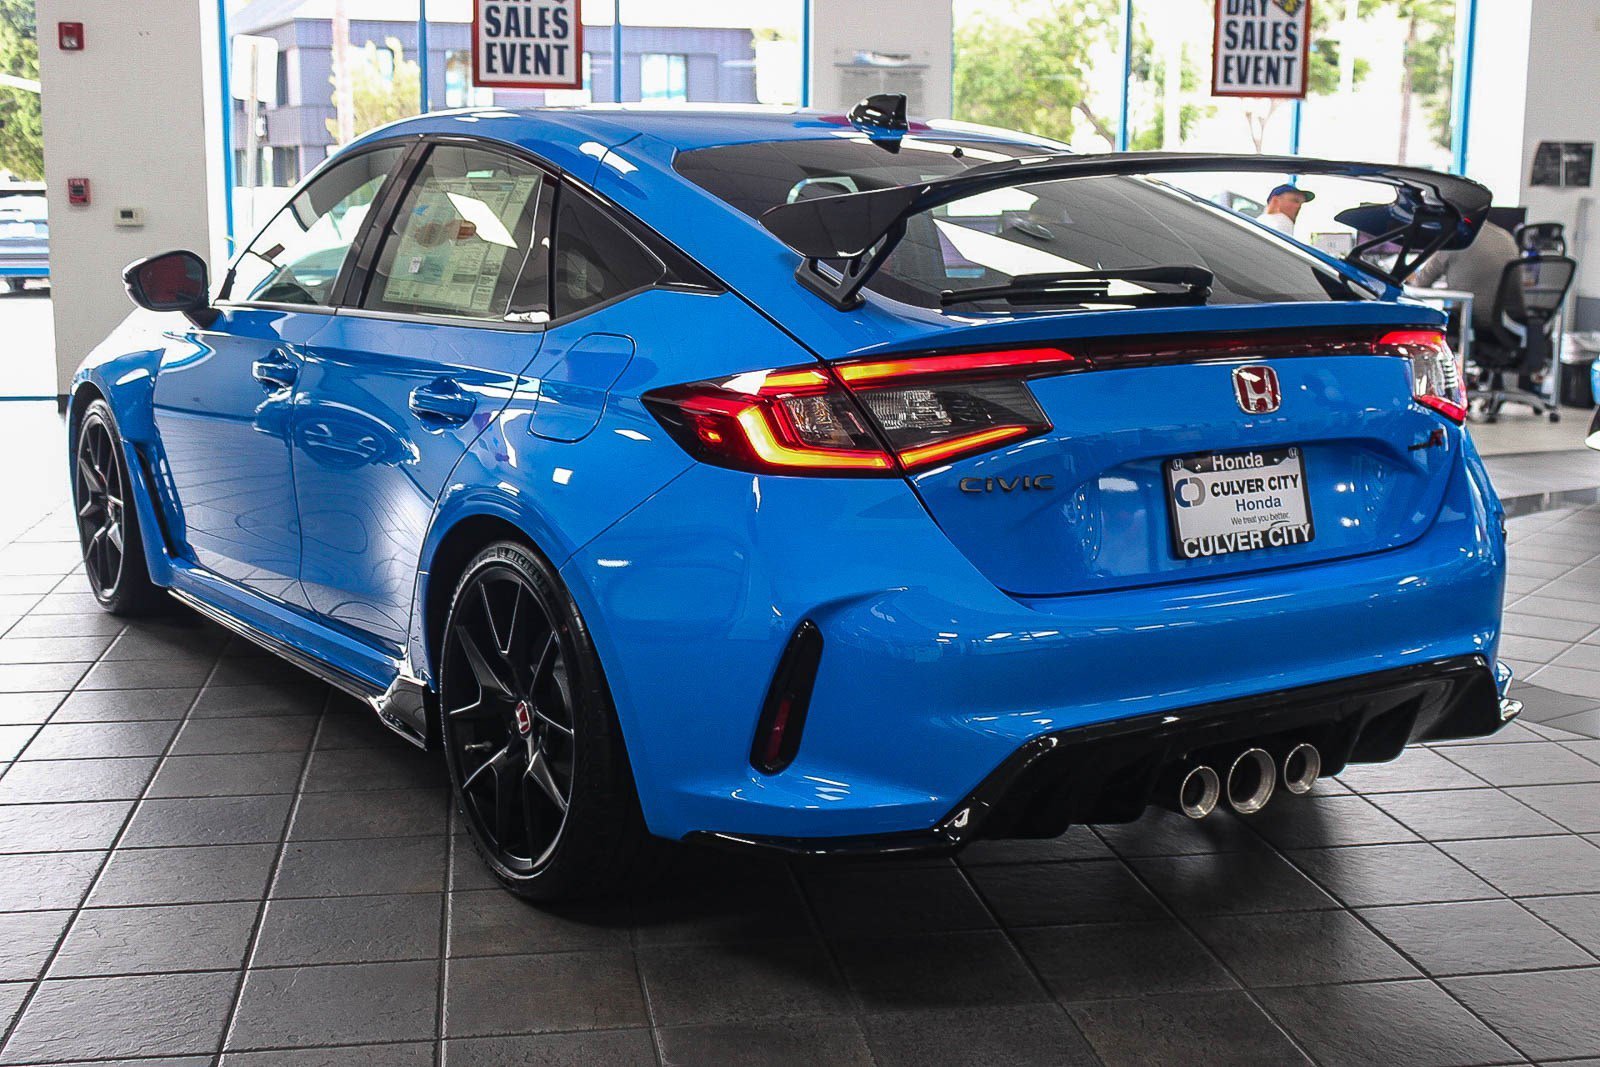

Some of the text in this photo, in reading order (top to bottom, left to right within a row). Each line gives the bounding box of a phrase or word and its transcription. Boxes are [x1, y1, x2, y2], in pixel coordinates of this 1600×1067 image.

[485, 5, 569, 39] SALES
[1225, 20, 1297, 51] SALES
[486, 42, 569, 75] EVENT
[1223, 55, 1297, 85] EVENT
[1212, 452, 1264, 471] Honda
[960, 475, 1056, 492] CIVIC
[1210, 474, 1299, 497] CULVER CITY
[1236, 496, 1281, 512] Honda
[1231, 516, 1242, 525] We
[1258, 515, 1269, 524] you
[1184, 523, 1311, 558] CULVER CITY
